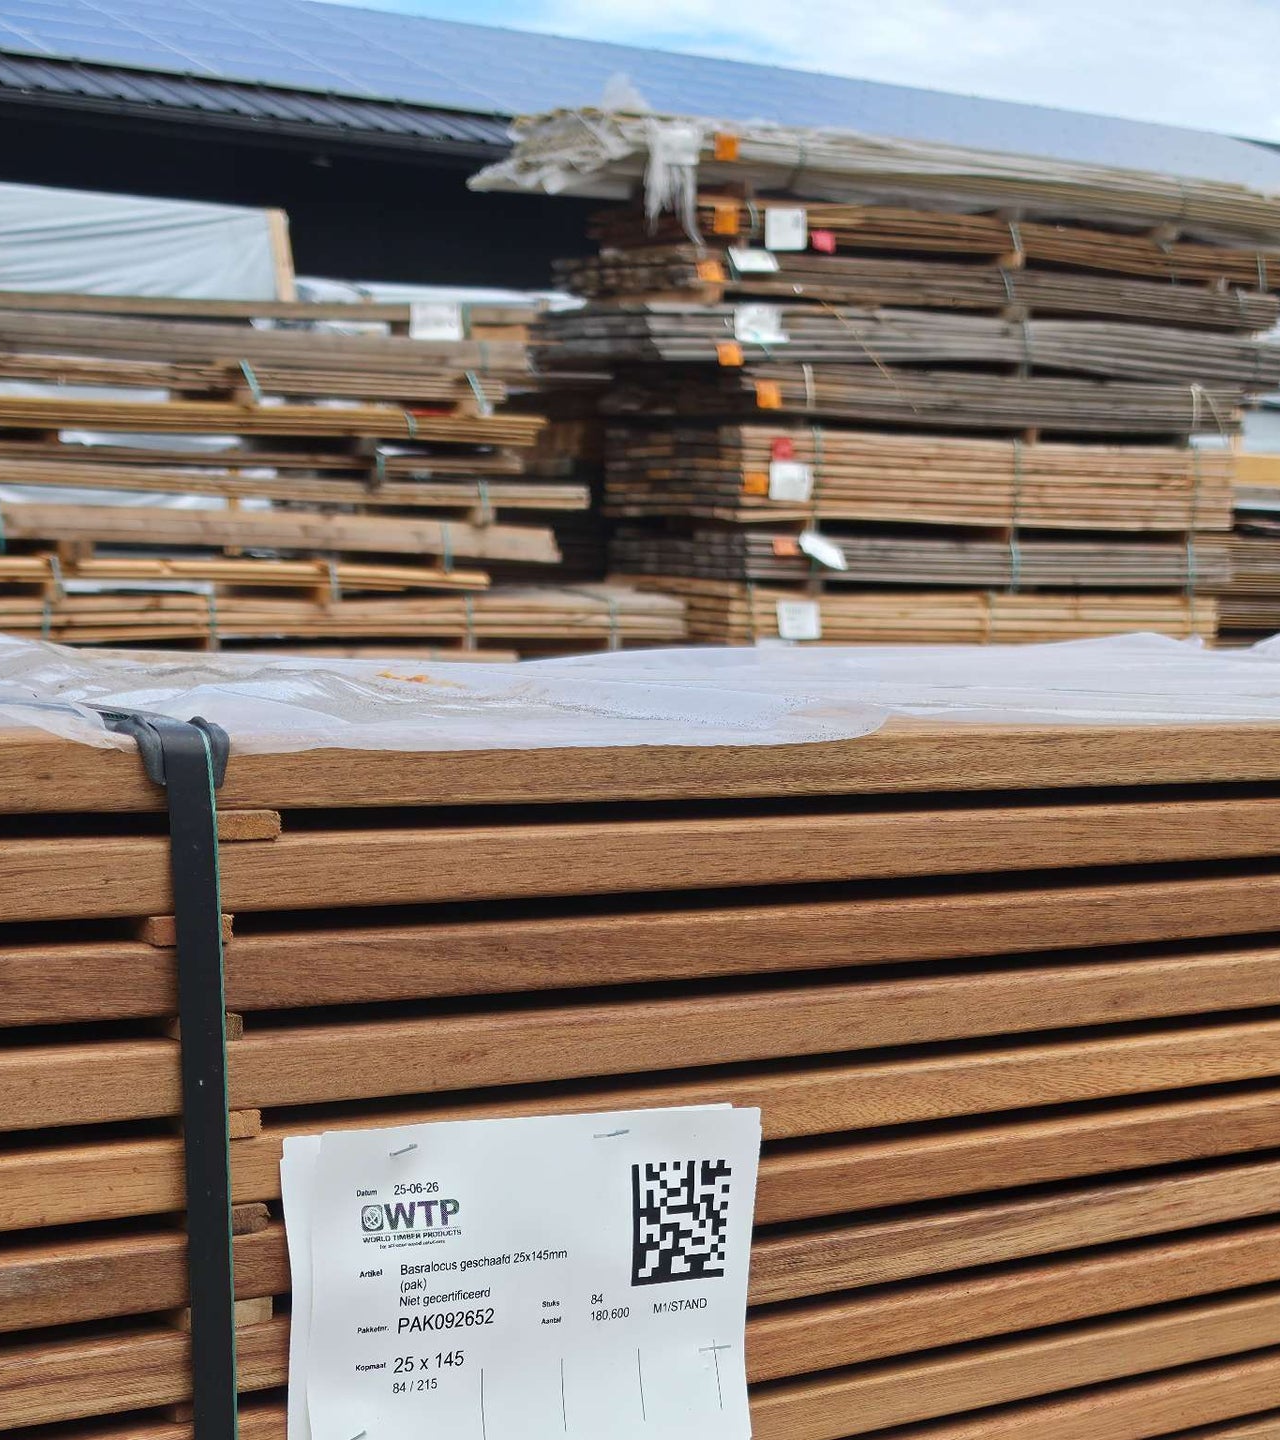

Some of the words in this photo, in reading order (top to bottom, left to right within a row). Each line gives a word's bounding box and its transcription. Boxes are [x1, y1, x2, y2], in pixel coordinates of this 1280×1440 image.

[356, 1189, 378, 1197] Datum
[393, 1182, 439, 1196] 25-06-26
[383, 1199, 460, 1230] WTP
[362, 1234, 391, 1244] WORLD
[393, 1231, 421, 1241] TIMBER
[422, 1229, 462, 1239] PRODUCTS
[359, 1268, 383, 1279] Artikel
[400, 1260, 458, 1276] Basralocus
[459, 1254, 511, 1272] geschaafd
[512, 1249, 568, 1264] 25x145mm
[400, 1277, 428, 1294] (pak)
[399, 1295, 421, 1308] Niet
[422, 1287, 491, 1307] gecertificeerd
[541, 1300, 561, 1308] Stuks
[590, 1293, 604, 1305] 84
[653, 1297, 708, 1314] M1/STAND
[357, 1324, 390, 1335] Pakketnr.
[397, 1308, 495, 1335] PAK092652
[541, 1316, 562, 1325] Aantal
[355, 1362, 387, 1372] Kopmaat
[393, 1356, 414, 1374] 25
[419, 1358, 429, 1371] x
[435, 1350, 464, 1369] 145
[392, 1381, 407, 1394] 84
[417, 1378, 438, 1391] 215
